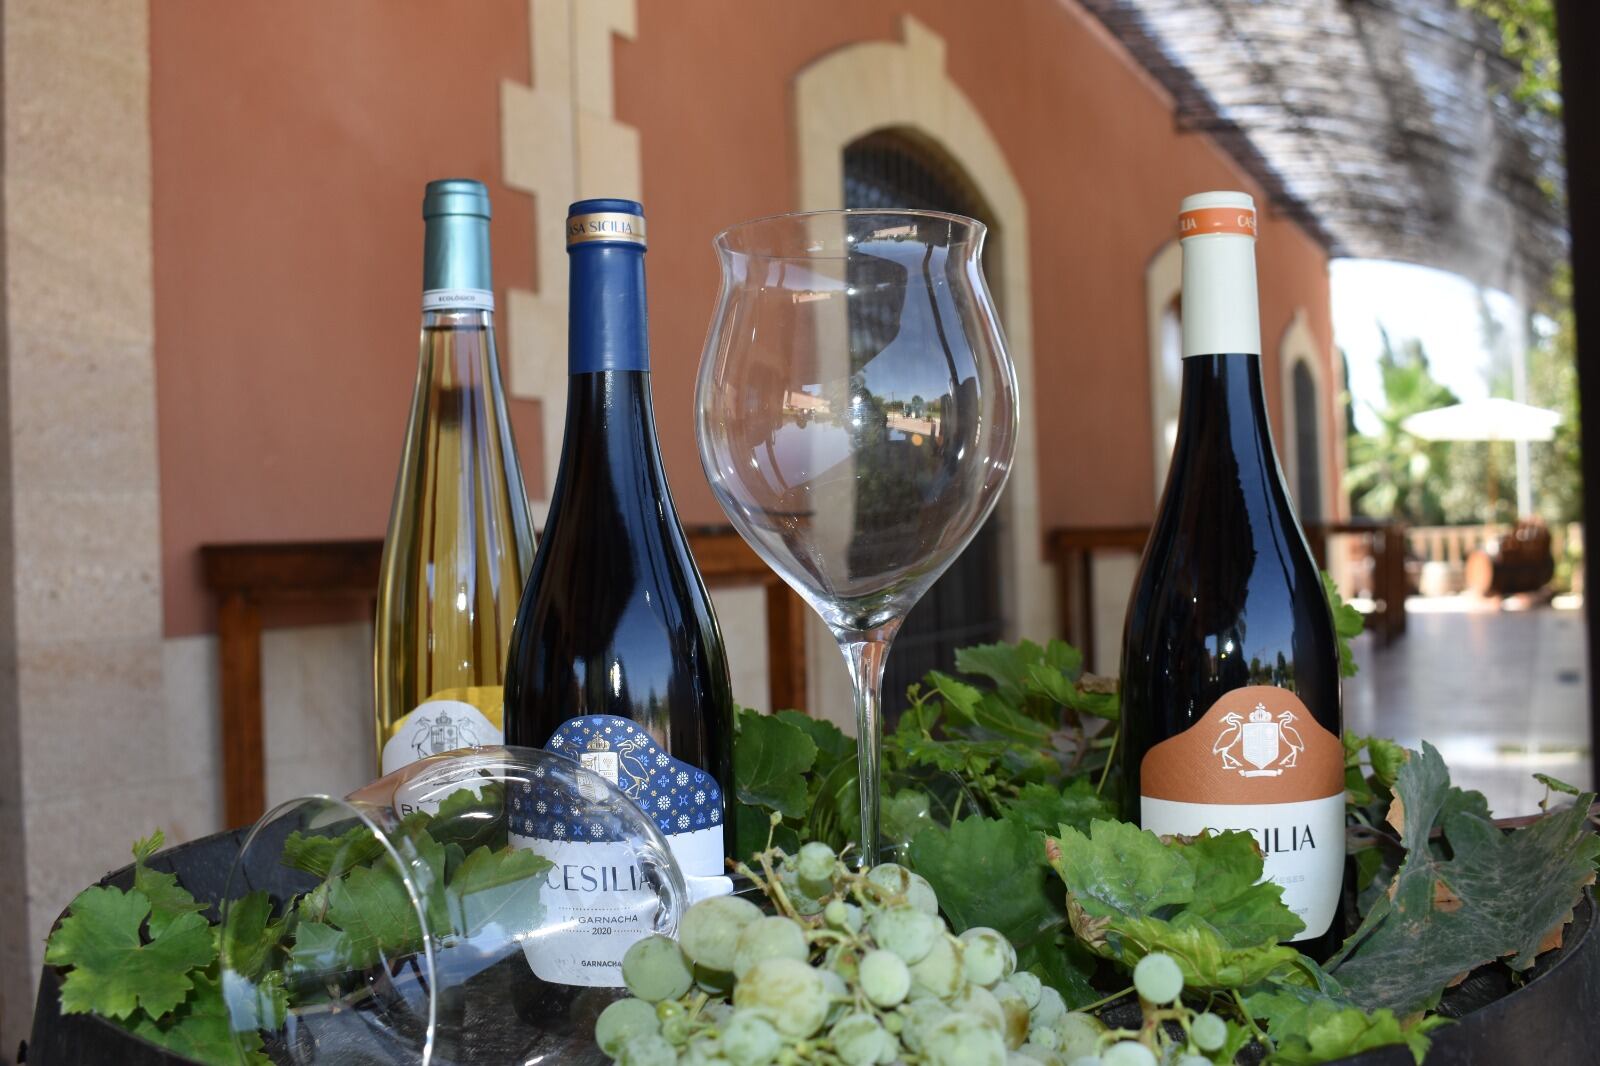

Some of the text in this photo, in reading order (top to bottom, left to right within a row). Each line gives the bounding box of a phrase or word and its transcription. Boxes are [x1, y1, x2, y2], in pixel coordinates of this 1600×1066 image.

[568, 220, 633, 235] ASA SICILIA
[1181, 217, 1198, 231] LIA
[1207, 824, 1316, 853] ILIA
[578, 914, 638, 924] GARNACHA
[592, 927, 612, 936] 2020
[581, 960, 622, 968] GARNACHA
